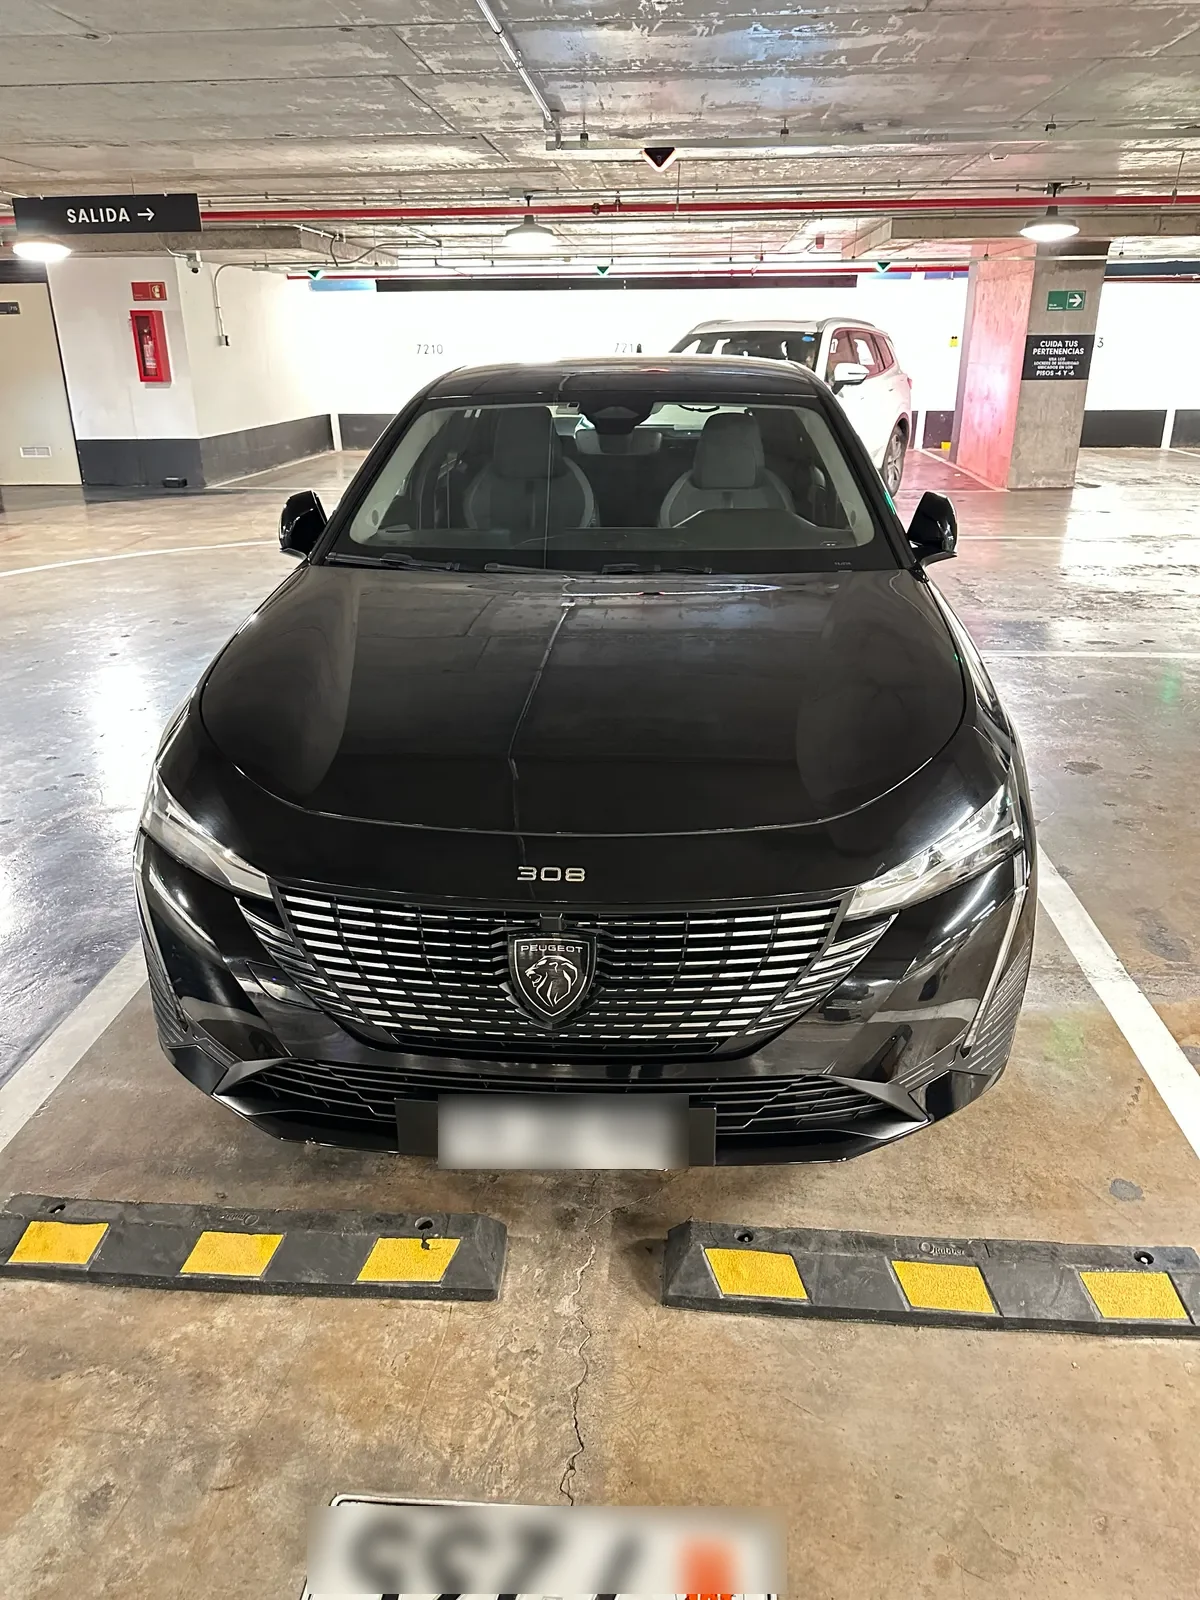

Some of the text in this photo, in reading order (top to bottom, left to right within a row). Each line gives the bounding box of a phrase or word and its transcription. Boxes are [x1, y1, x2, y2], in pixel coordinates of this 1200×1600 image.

[66, 207, 131, 224] SALIDA
[416, 343, 444, 355] 7210
[614, 342, 642, 353] 721
[1040, 340, 1079, 348] CUIDA TUS
[1032, 347, 1085, 355] PERTENENCIAS
[516, 866, 586, 882] 308
[520, 944, 584, 953] PEUGEOT
